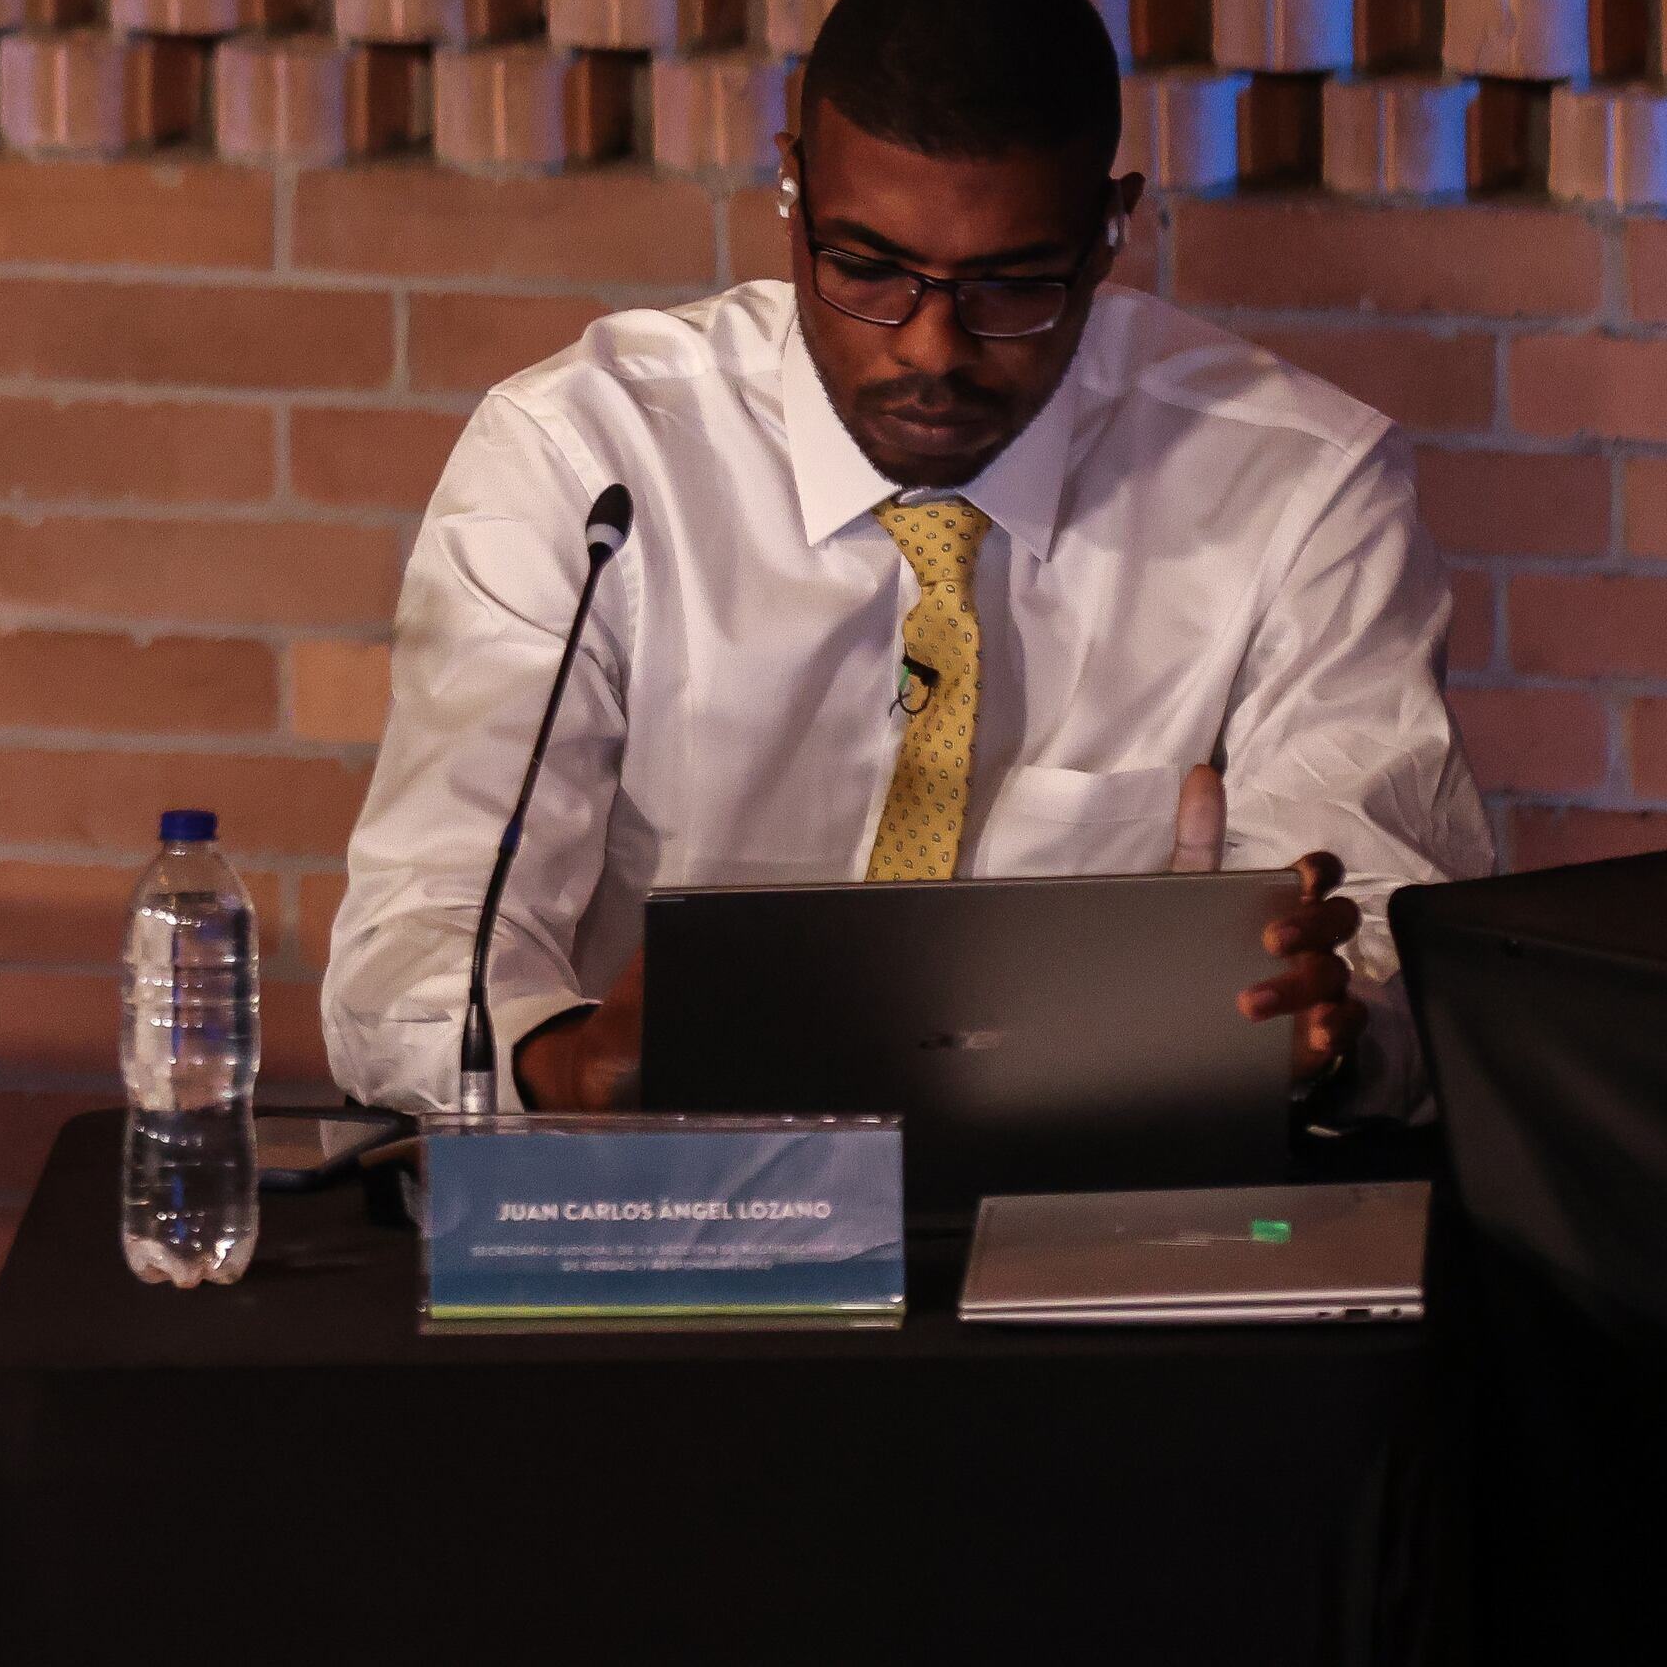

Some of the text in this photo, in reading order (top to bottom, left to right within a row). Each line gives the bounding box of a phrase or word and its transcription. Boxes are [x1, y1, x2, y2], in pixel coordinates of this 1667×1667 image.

[499, 1197, 833, 1221] JUAN CARLOS ÁNGEL LOZANO
